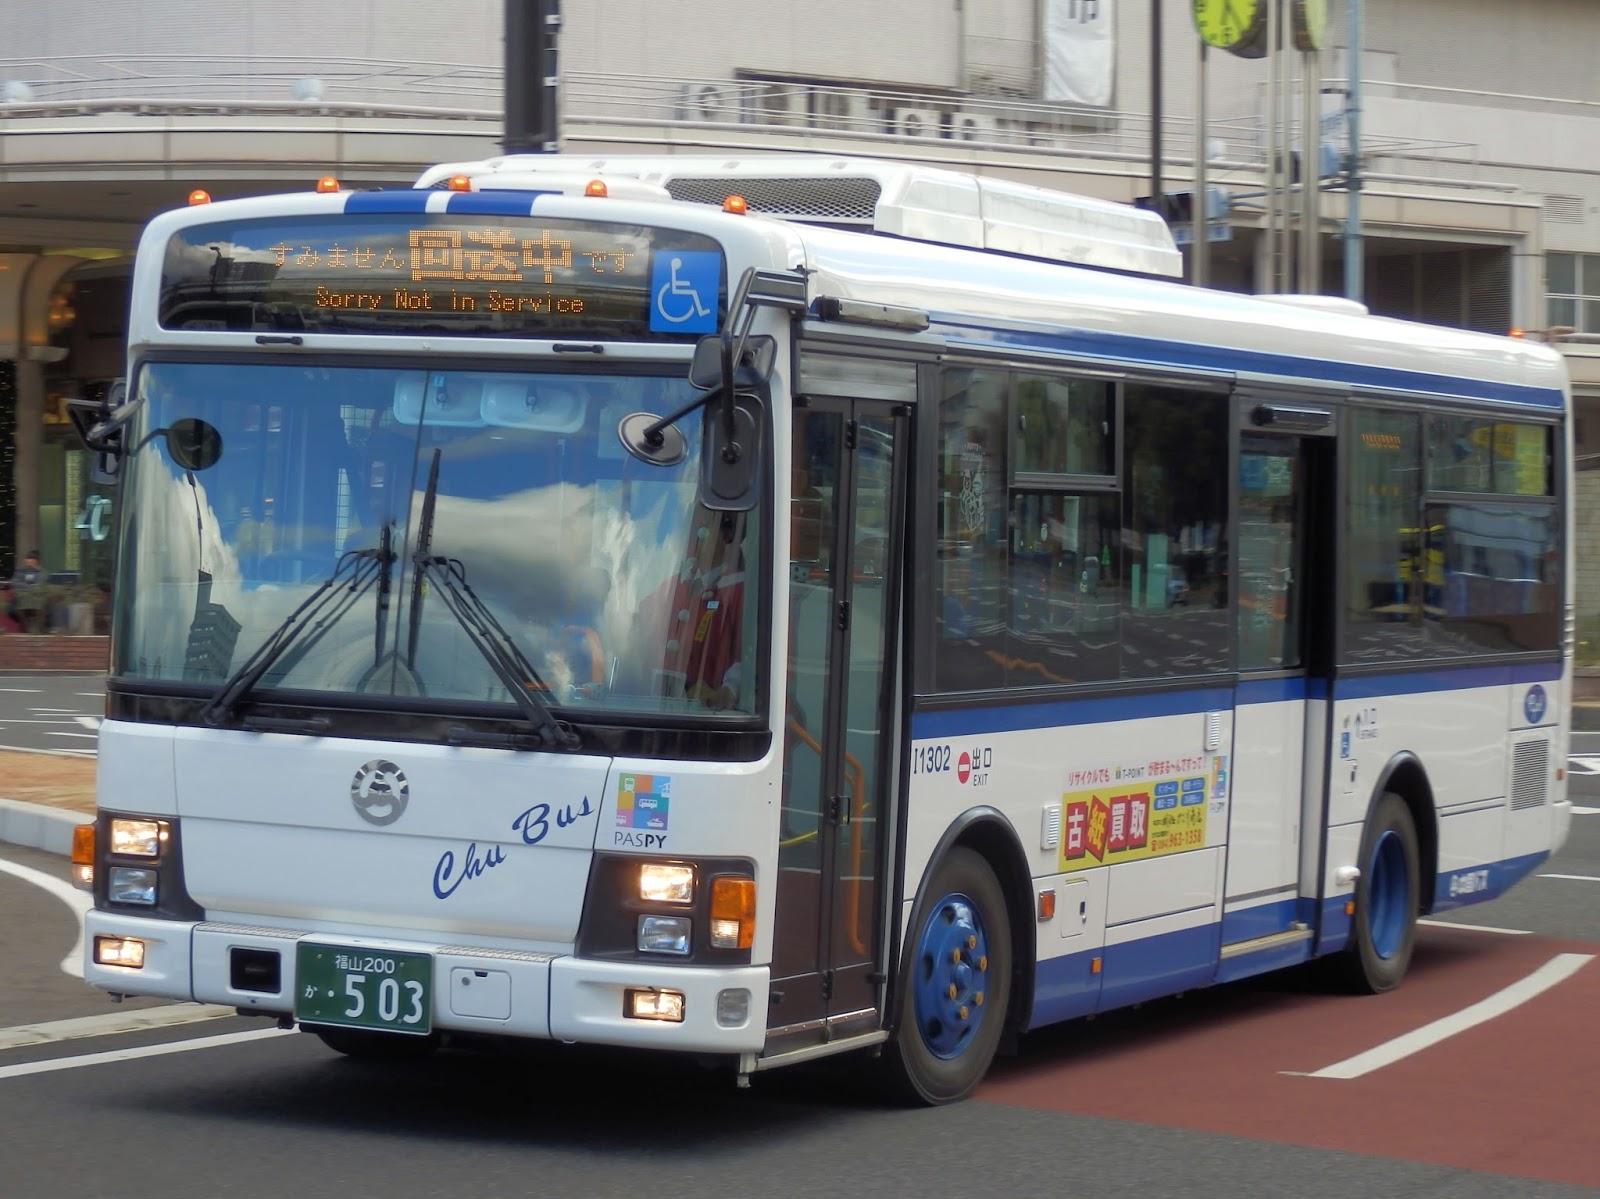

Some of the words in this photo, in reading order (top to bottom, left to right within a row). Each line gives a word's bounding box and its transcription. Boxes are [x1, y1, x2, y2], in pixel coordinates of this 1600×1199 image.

[316, 286, 382, 310] Sorry
[394, 287, 432, 310] Not
[451, 288, 475, 311] in
[488, 289, 584, 313] Service
[971, 747, 992, 770] 出口
[973, 773, 989, 787] EXIT
[1068, 767, 1110, 787] リサイクルでも
[1067, 799, 1147, 851] 古紙買取
[433, 842, 507, 900] Chu
[511, 795, 595, 845] Bus
[614, 831, 668, 849] PASPY
[304, 984, 318, 999] か
